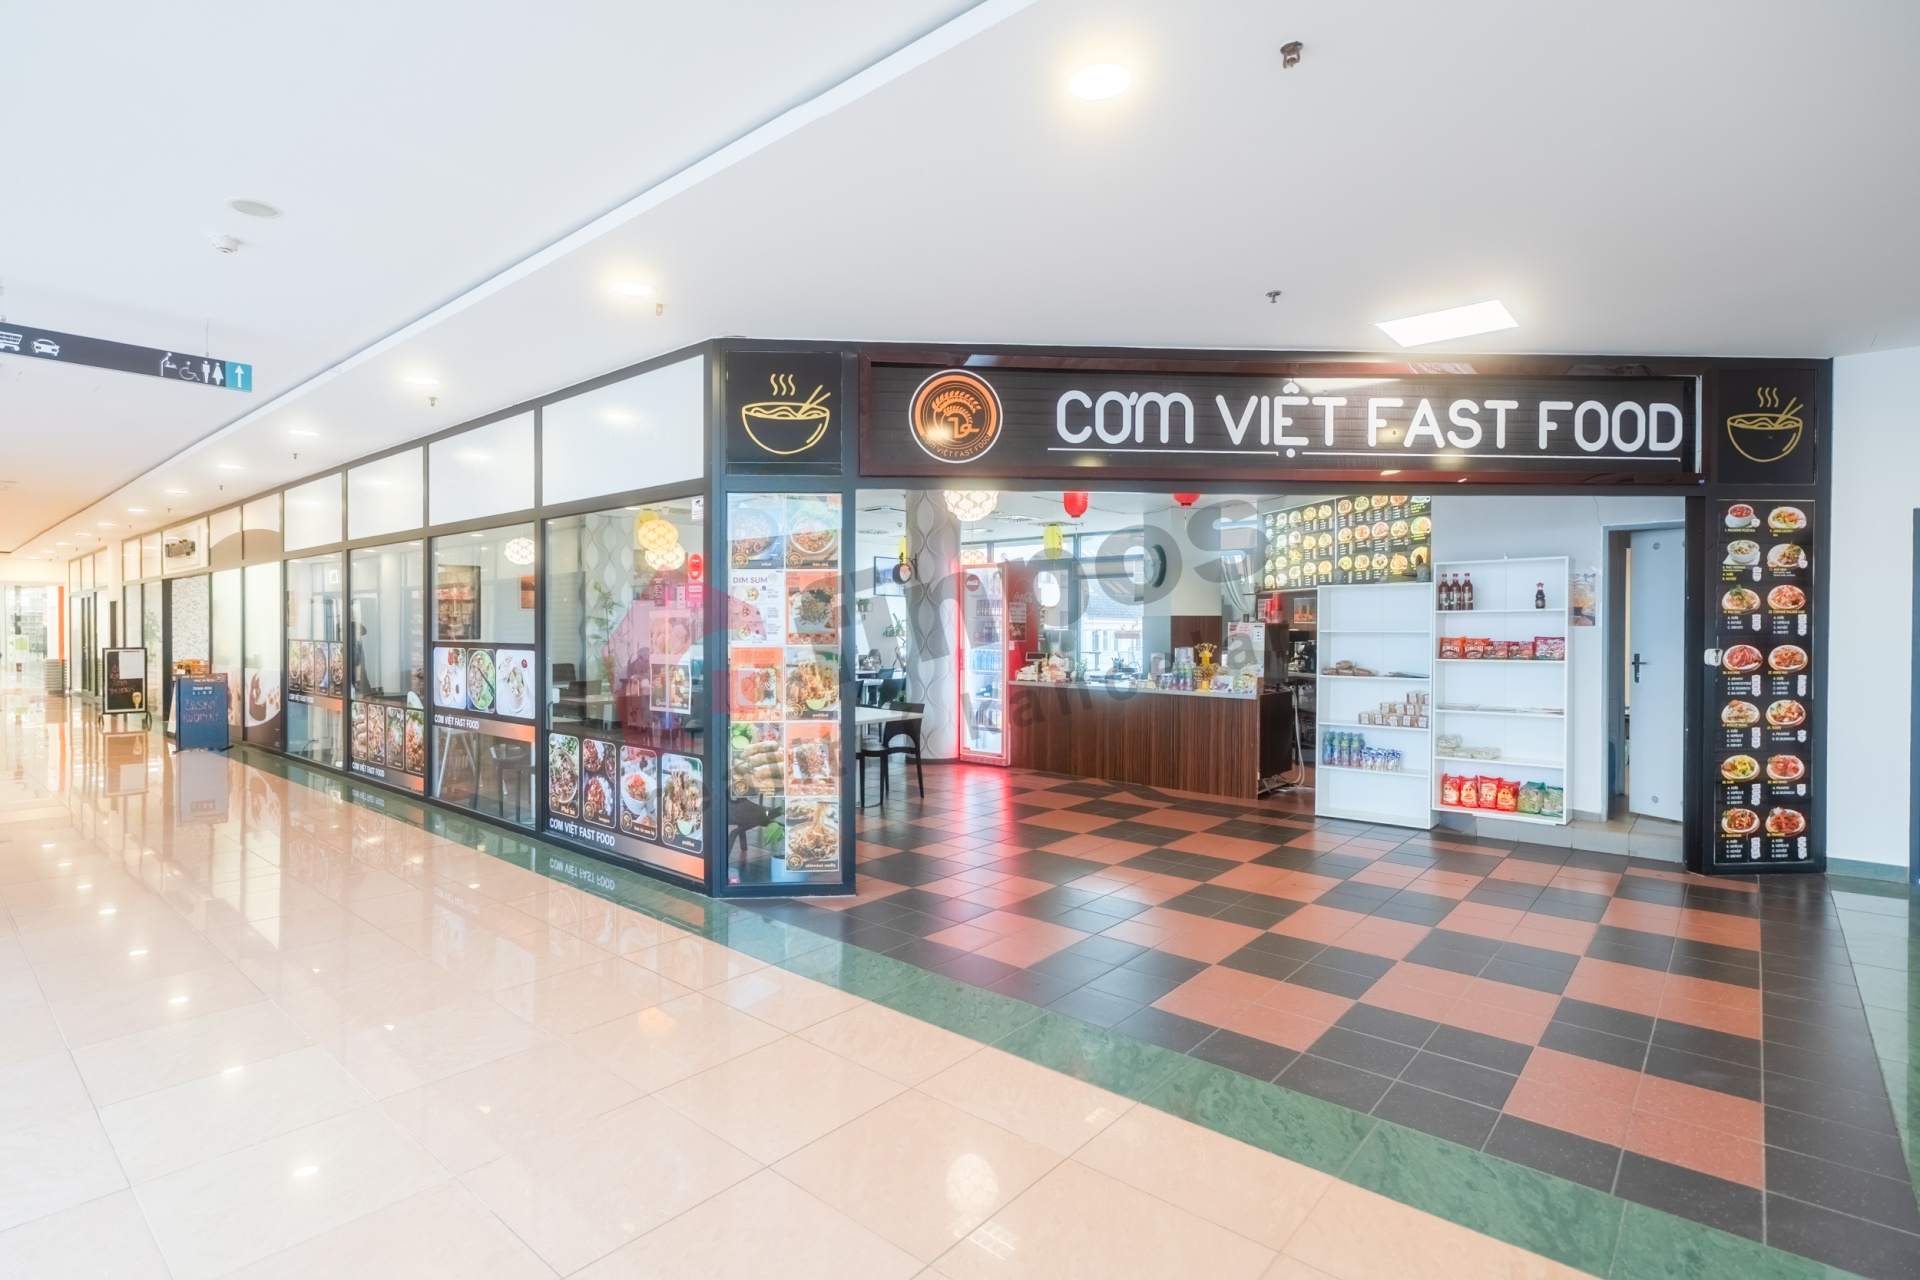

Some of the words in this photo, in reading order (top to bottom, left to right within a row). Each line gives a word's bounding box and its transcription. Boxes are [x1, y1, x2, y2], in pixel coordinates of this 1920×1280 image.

[1216, 382, 1347, 458] VIỆT
[1368, 398, 1518, 450] FAST
[1538, 401, 1683, 453] FOOD
[955, 449, 973, 458] FAST
[975, 435, 991, 451] FOOD
[733, 576, 748, 584] DIM
[751, 576, 768, 584] SUM
[1442, 645, 1460, 653] KIMCHI
[1465, 645, 1484, 653] KIMCHI
[455, 718, 465, 728] FAST
[466, 719, 479, 730] FOOD
[579, 826, 596, 841] FAST
[596, 831, 616, 847] FOOD
